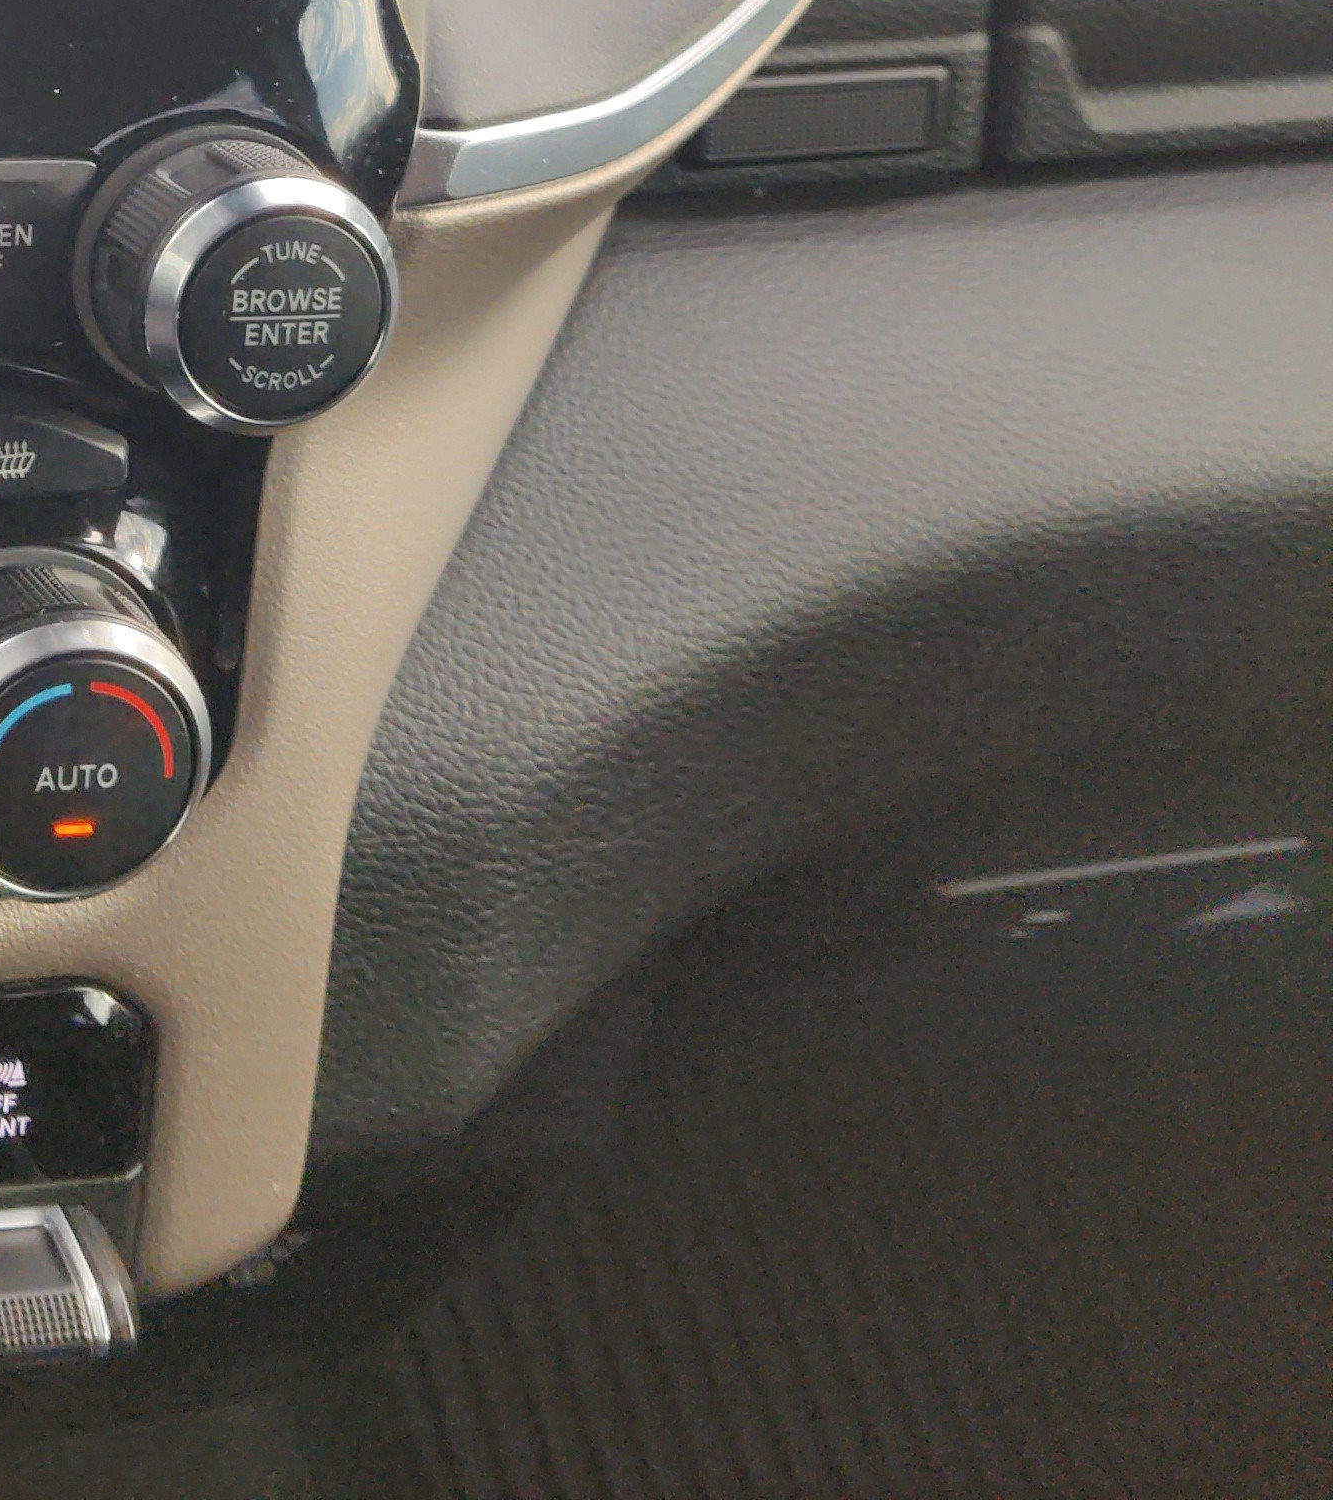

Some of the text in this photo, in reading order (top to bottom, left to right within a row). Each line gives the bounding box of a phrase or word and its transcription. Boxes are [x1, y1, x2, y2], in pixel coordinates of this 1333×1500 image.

[261, 241, 322, 266] TUNE
[232, 287, 342, 313] BROWSE
[244, 323, 329, 348] ENTER
[241, 365, 324, 392] SCROLL
[35, 763, 119, 793] AUTO
